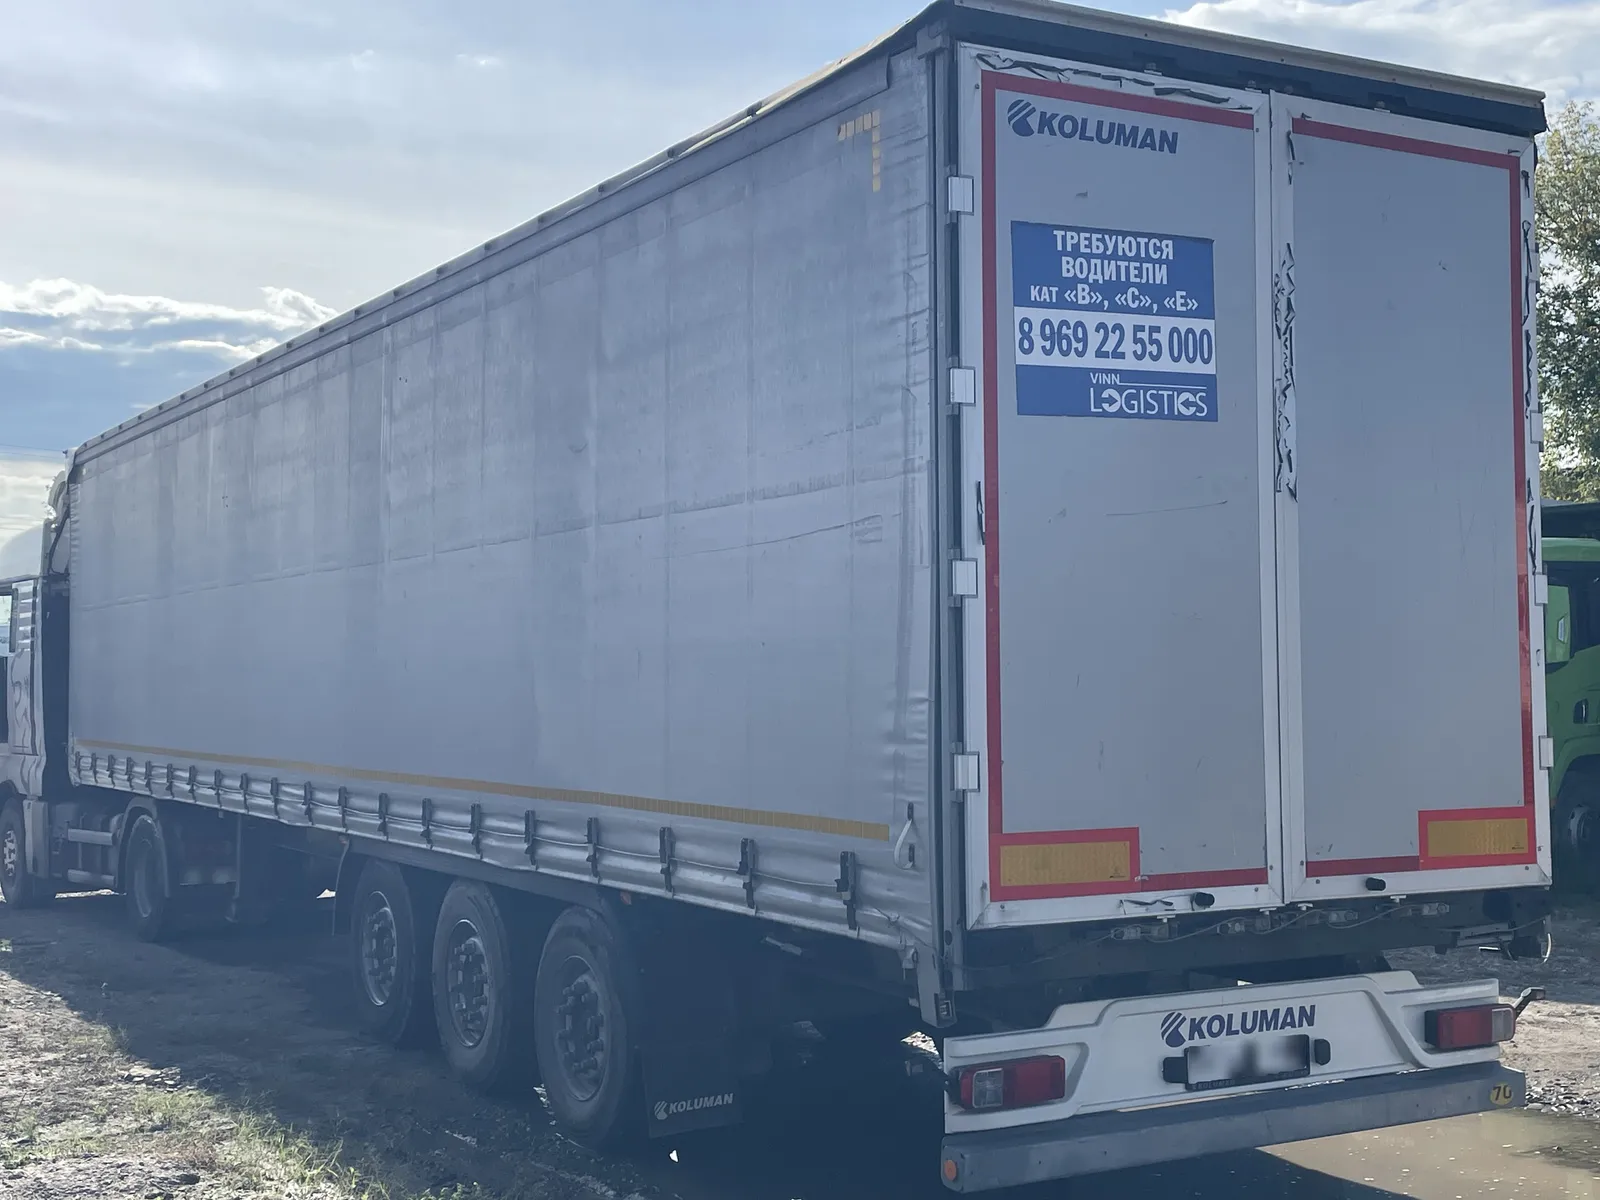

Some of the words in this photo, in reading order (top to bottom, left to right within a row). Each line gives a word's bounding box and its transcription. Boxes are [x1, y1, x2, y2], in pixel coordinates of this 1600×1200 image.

[1037, 111, 1179, 154] KOLUMAN
[1053, 230, 1174, 260] ТРЕБУЮТСЯ
[1061, 256, 1168, 284] ВОДИТЕЛИ
[1030, 285, 1059, 302] КАТ
[1018, 317, 1034, 355] 8
[1039, 318, 1088, 358] 969
[1094, 321, 1126, 360] 22
[1132, 324, 1162, 362] 55
[1168, 326, 1213, 365] 000
[1090, 372, 1120, 384] VINN
[1090, 387, 1208, 416] LOGISTICS
[1188, 1004, 1316, 1041] KOLUMAN
[668, 1093, 734, 1114] KOLUMAN
